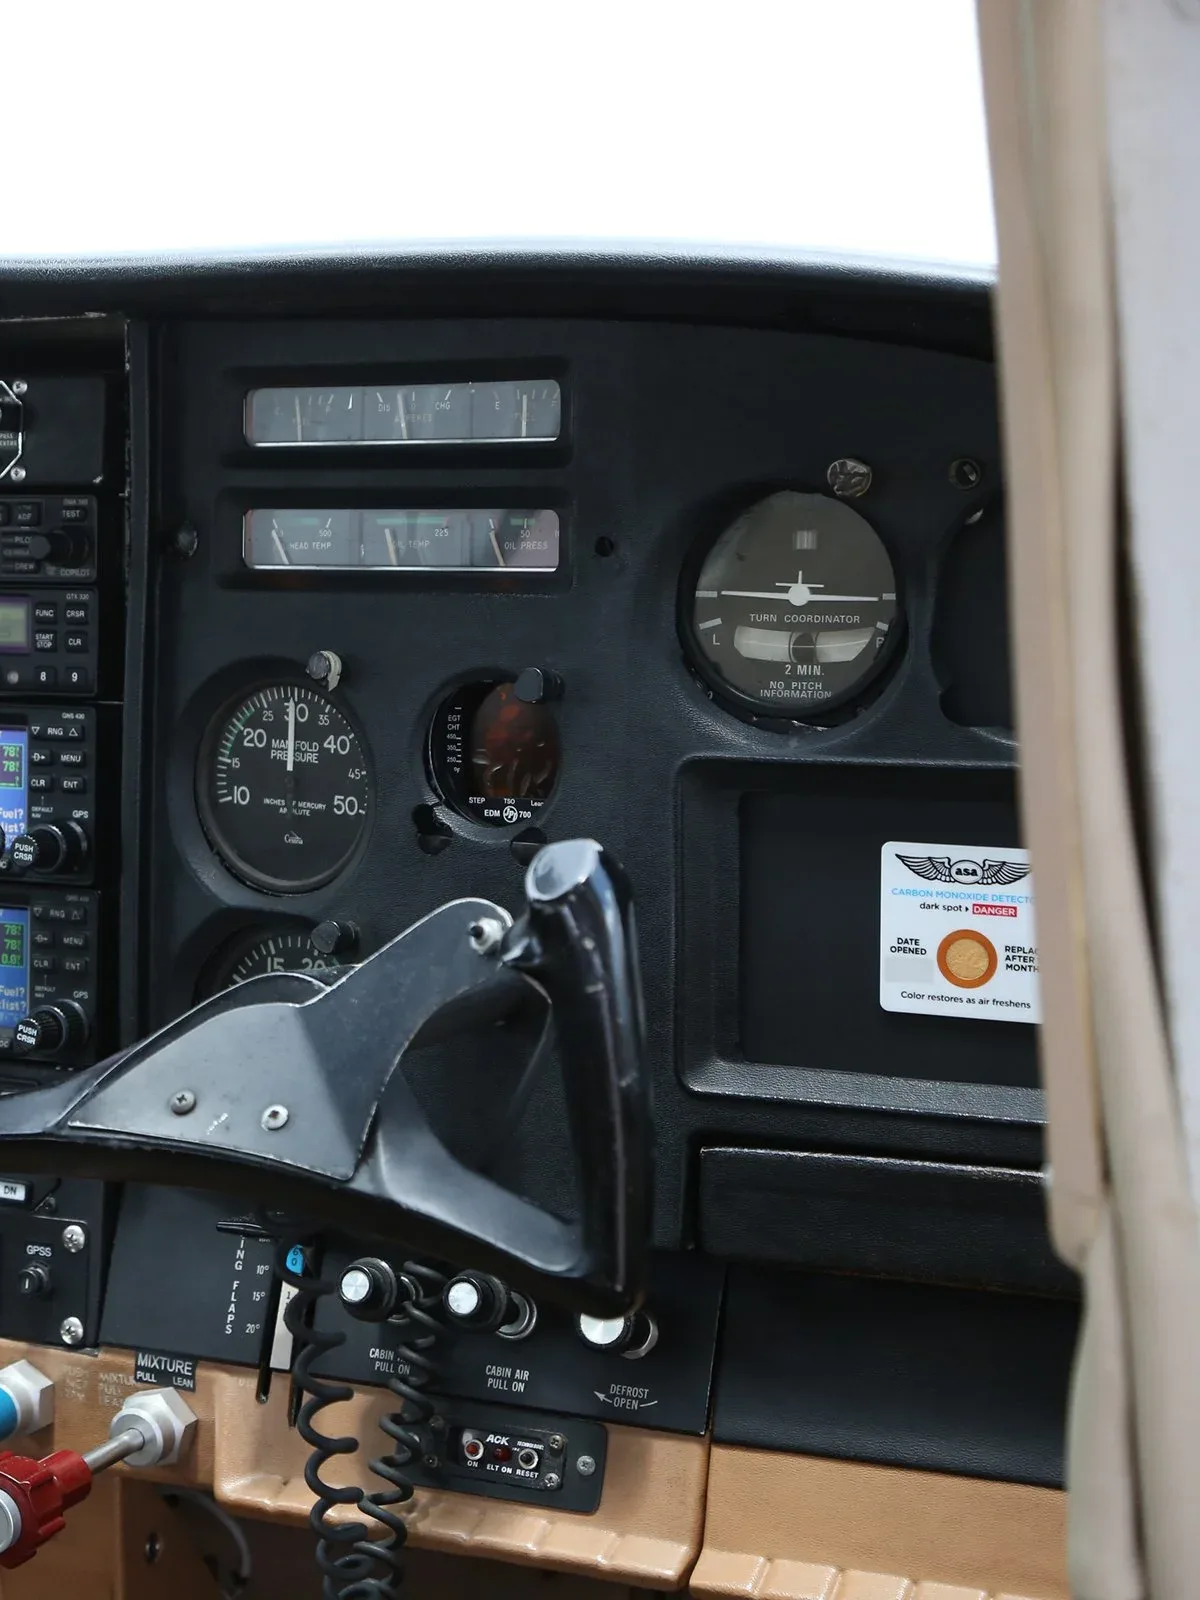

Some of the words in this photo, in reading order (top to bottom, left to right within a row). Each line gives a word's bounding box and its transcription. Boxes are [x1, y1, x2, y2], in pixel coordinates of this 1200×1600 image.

[435, 401, 451, 410] CHG
[62, 509, 81, 518] TEST
[434, 528, 449, 537] 225
[520, 529, 531, 538] 50
[289, 541, 309, 550] HEAD
[312, 541, 331, 550] TEMP
[504, 541, 517, 550] OIL
[520, 541, 548, 550] PRESS
[35, 608, 55, 618] FUNC
[66, 609, 85, 619] CRSR
[749, 613, 777, 624] TURN
[784, 614, 861, 625] COORDINATOR
[35, 632, 54, 641] START
[67, 637, 82, 647] CLR
[712, 633, 721, 646] L
[36, 640, 53, 649] STOP
[784, 664, 793, 676] 2
[797, 664, 825, 677] MIN.
[769, 681, 784, 691] NO
[791, 681, 823, 691] PITCH
[760, 689, 832, 700] INFORMATION
[262, 710, 275, 722] 25
[318, 714, 330, 726] 35
[447, 714, 461, 722] EGT
[47, 727, 64, 736] RNG
[447, 723, 460, 731] CHT
[243, 728, 267, 748] 20
[323, 734, 350, 755] 40
[60, 754, 81, 763] MENU
[232, 757, 241, 769] 15
[348, 768, 361, 780] 45
[30, 778, 46, 788] CLR
[63, 780, 79, 790] ENT
[233, 785, 250, 806] 10
[468, 796, 486, 804] STEP
[504, 797, 516, 805] TSO
[263, 798, 286, 806] INCHES
[297, 801, 326, 811] MERCURY
[333, 794, 358, 816] 50
[72, 809, 90, 819] GPS
[484, 809, 501, 818] EDM
[519, 810, 532, 819] 700
[14, 843, 34, 852] PUSH
[13, 852, 33, 862] CRSR
[954, 866, 979, 877] asa
[891, 887, 934, 899] CARBON
[935, 890, 989, 902] MONOXIDE
[50, 909, 65, 919] RNG
[919, 901, 940, 911] dark
[942, 903, 963, 914] spot
[973, 905, 1016, 917] DANGER
[63, 936, 84, 946] MENU
[896, 937, 921, 947] DATE
[890, 945, 928, 956] OPENED
[33, 960, 49, 968] CLR
[1004, 954, 1035, 964] AFTER
[65, 962, 81, 971] ENT
[73, 990, 89, 1000] GPS
[900, 990, 926, 1001] Color
[927, 993, 964, 1004] restores
[965, 996, 976, 1005] as
[978, 996, 990, 1006] air
[992, 998, 1032, 1010] freshens
[18, 1024, 37, 1037] PUSH
[16, 1033, 36, 1046] CRSR
[3, 1185, 17, 1196] DN
[26, 1245, 53, 1257] GPSS
[225, 1280, 241, 1335] FLAPS
[370, 1348, 394, 1361] CABIN
[137, 1353, 193, 1376] MIXTURE
[375, 1361, 395, 1373] PULL
[398, 1363, 411, 1376] ON
[485, 1364, 511, 1379] CABIN
[515, 1368, 530, 1381] AIR
[136, 1371, 157, 1383] PULL
[172, 1376, 194, 1388] LEAN
[487, 1378, 508, 1391] PULL
[511, 1382, 526, 1393] ON
[610, 1384, 650, 1399] DEFROST
[613, 1397, 639, 1410] OPEN
[486, 1433, 511, 1446] ACK
[466, 1459, 479, 1468] ON
[486, 1463, 500, 1472] ELT
[501, 1465, 513, 1475] ON
[515, 1468, 539, 1479] RESET
